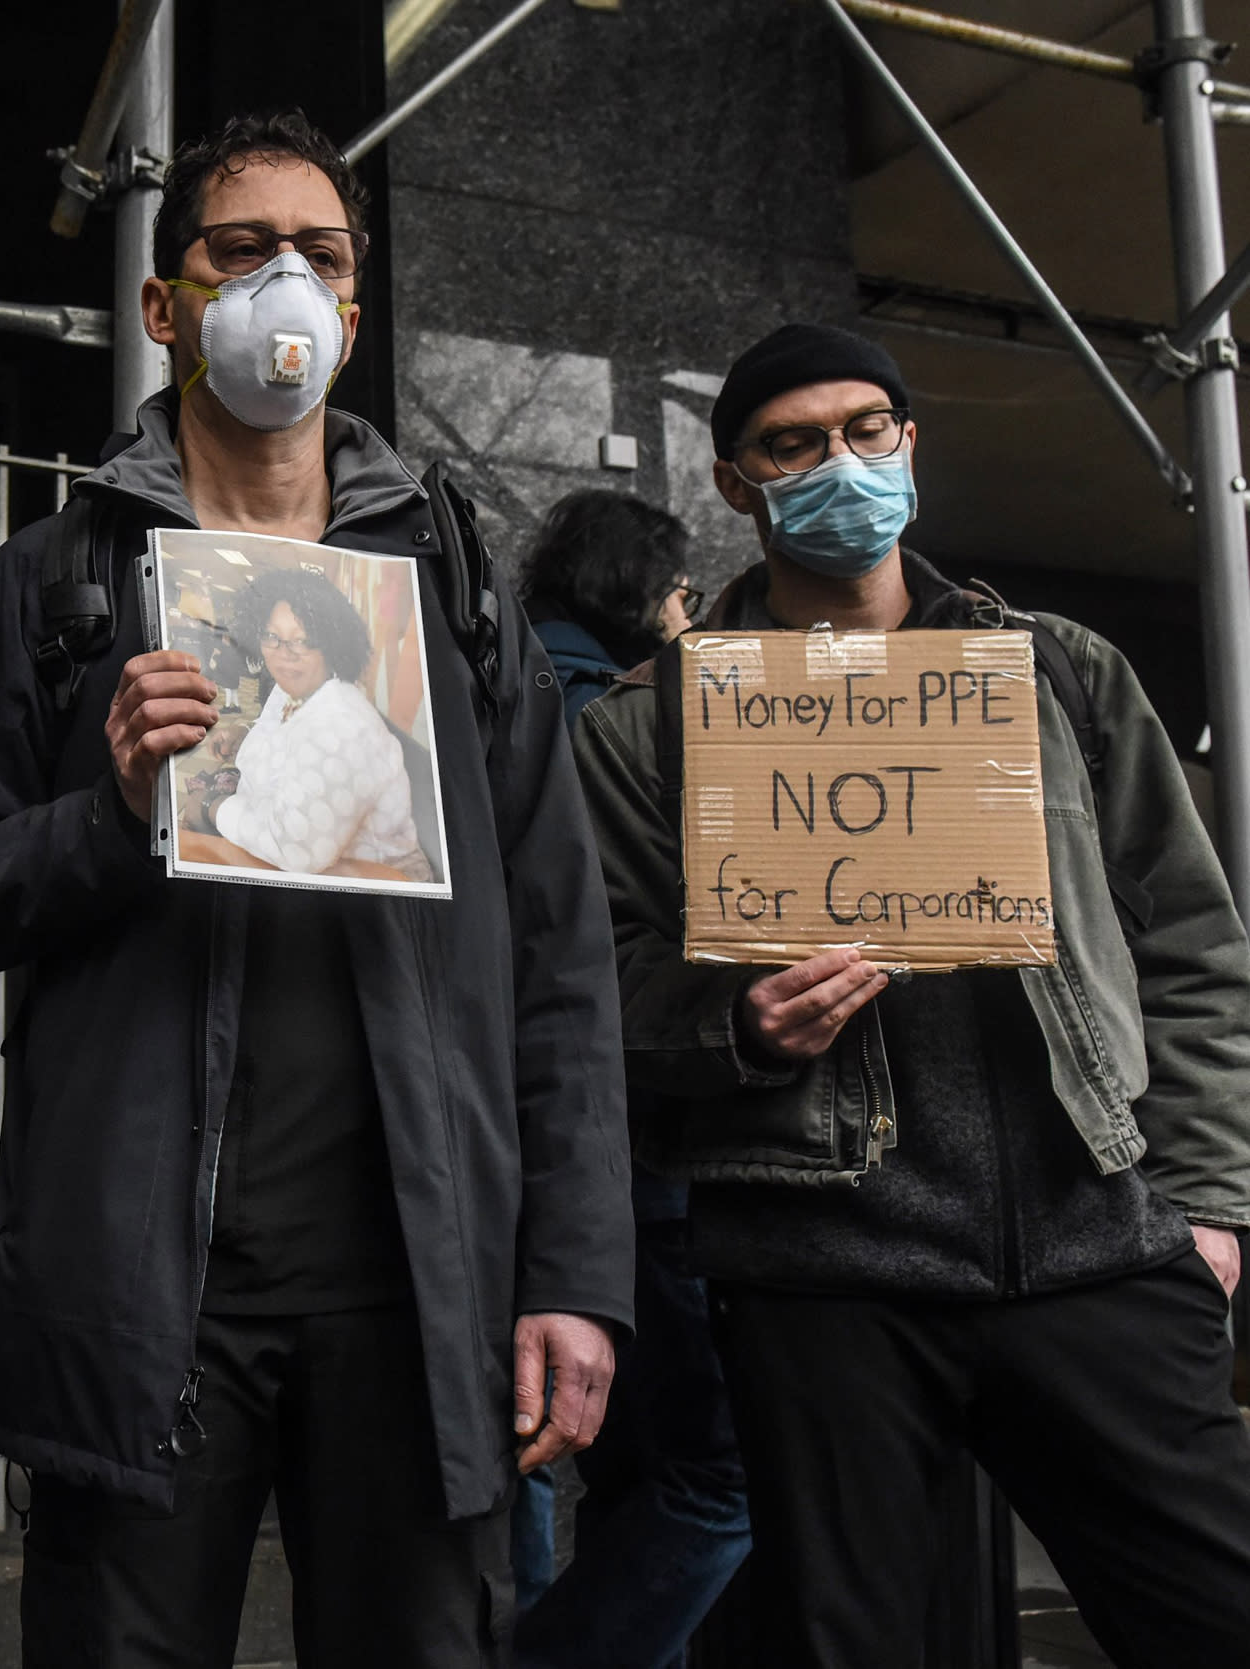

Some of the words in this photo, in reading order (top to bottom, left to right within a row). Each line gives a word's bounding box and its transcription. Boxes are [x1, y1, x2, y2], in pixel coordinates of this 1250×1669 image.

[699, 664, 835, 736] Money
[845, 673, 908, 728] For
[918, 670, 1015, 727] PPE
[771, 766, 943, 835] NOT
[707, 854, 798, 921] for
[825, 856, 1049, 932] Corporations
